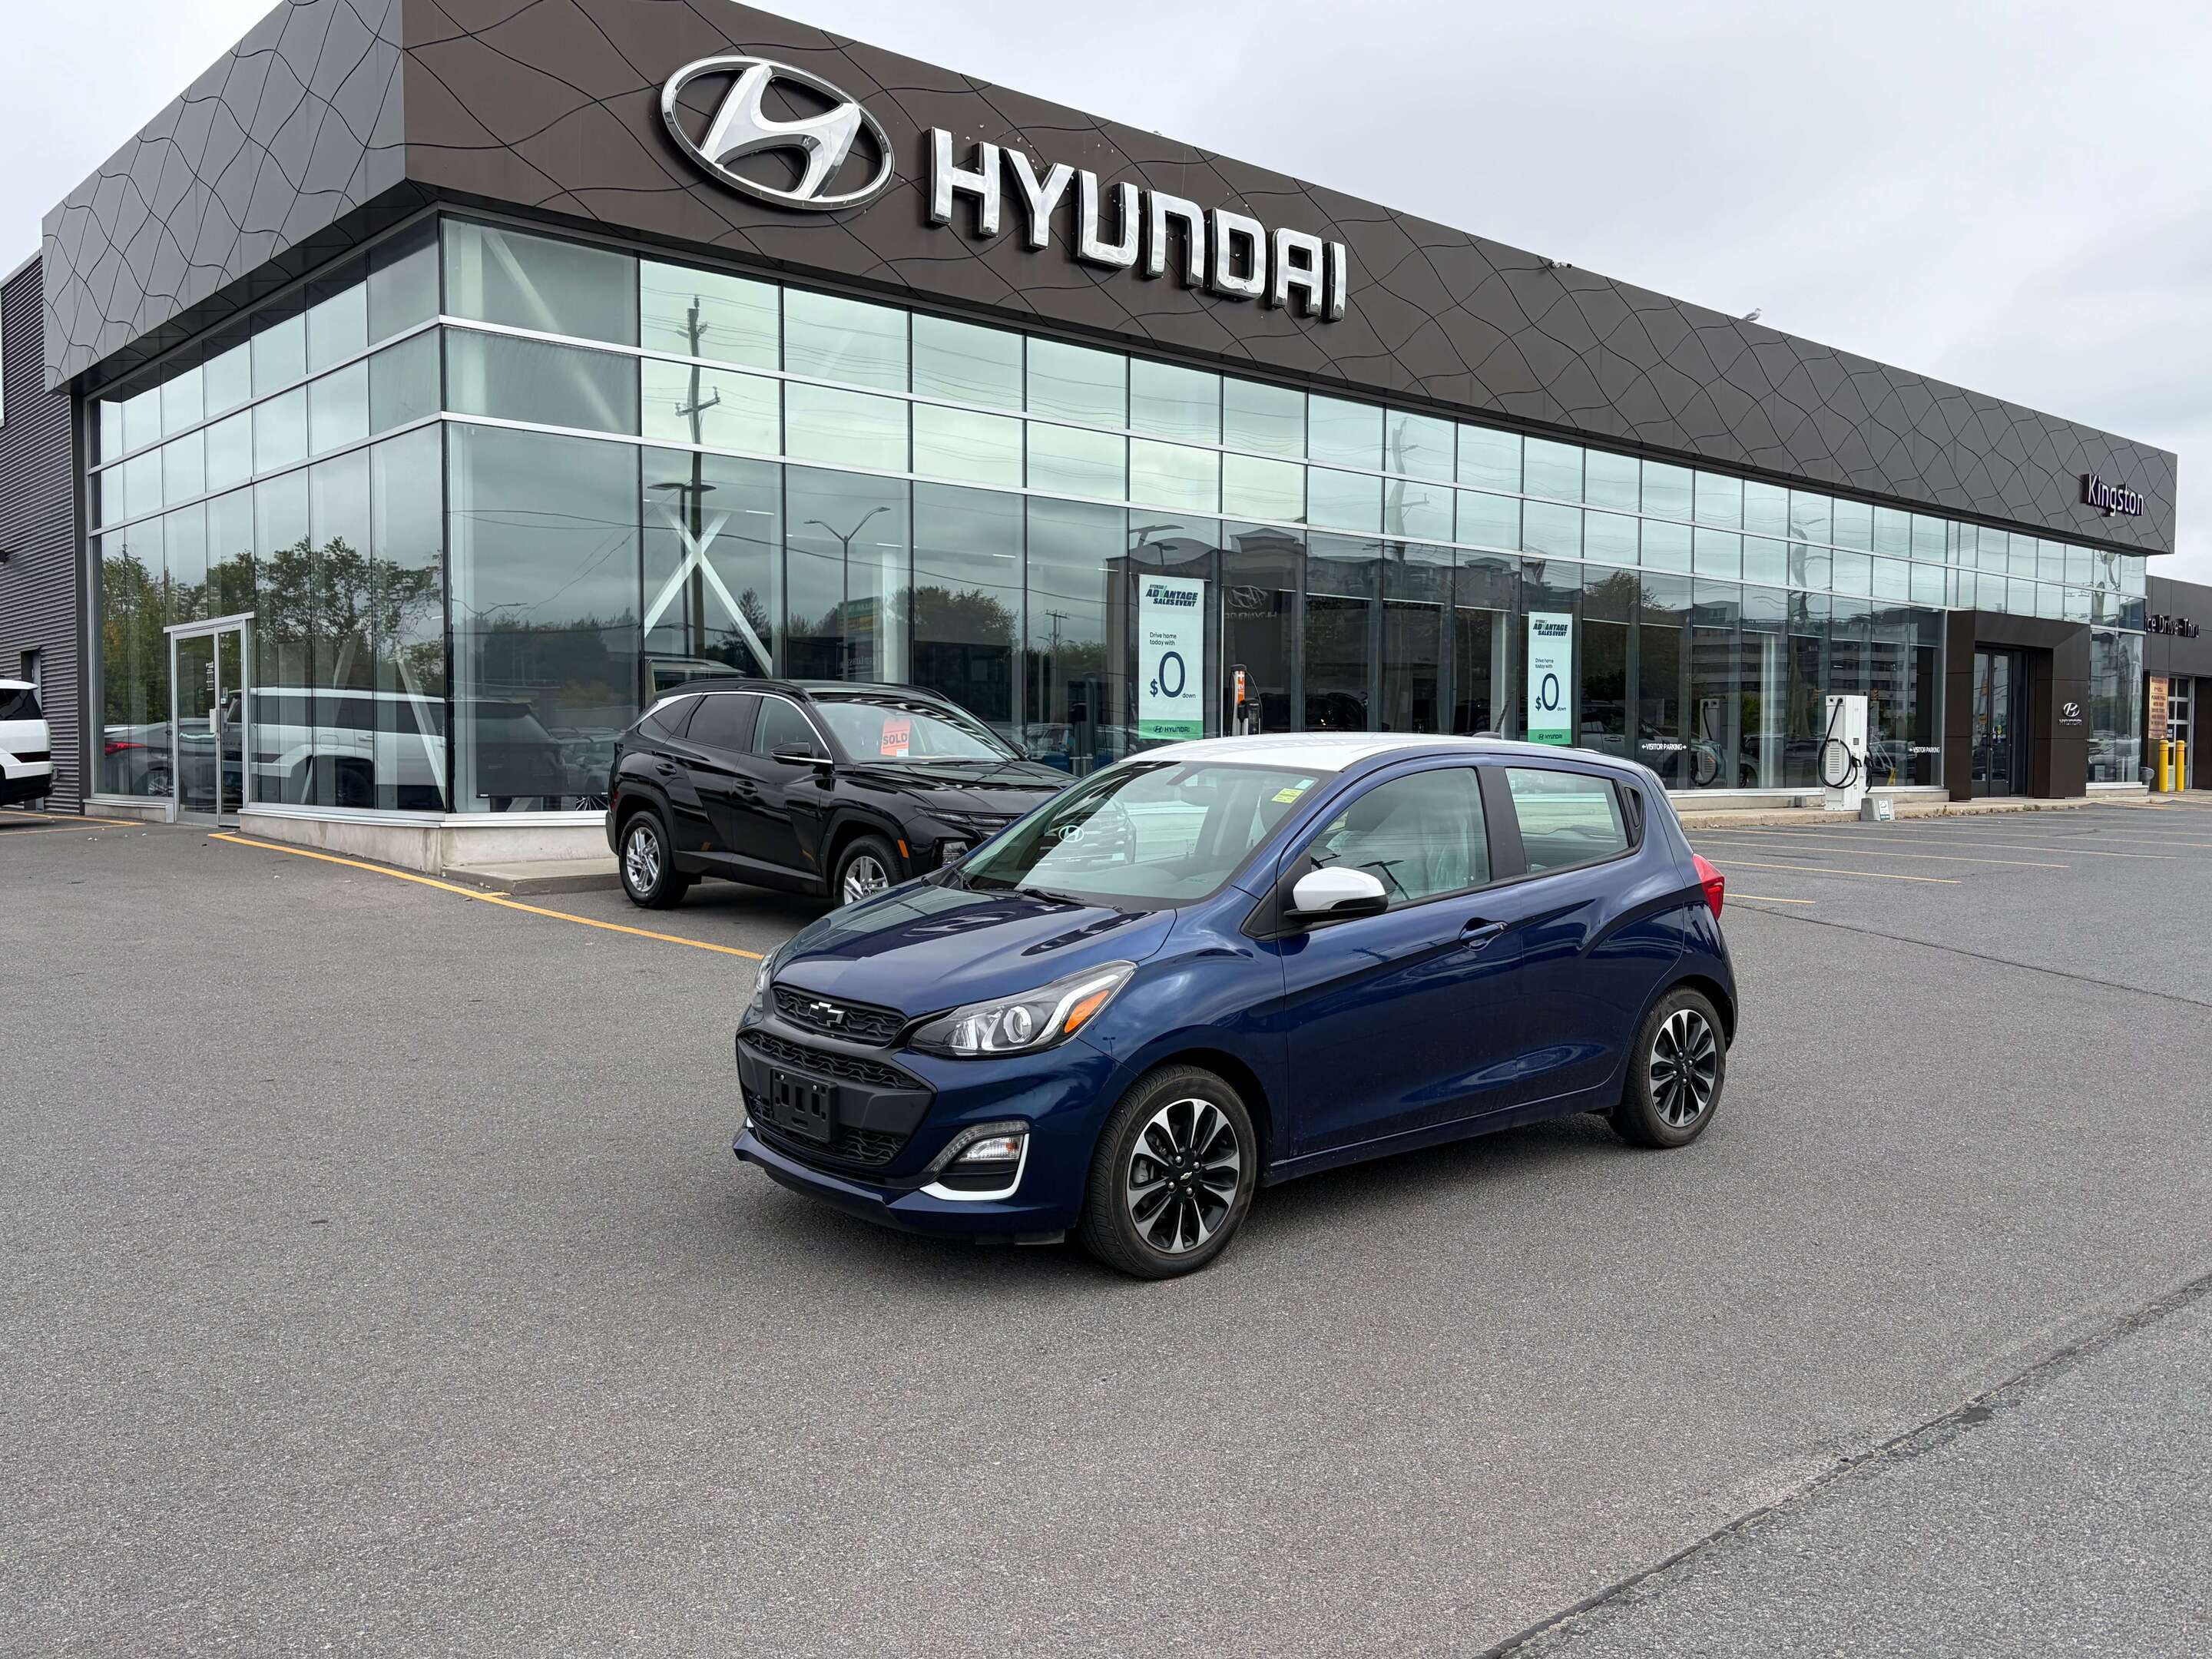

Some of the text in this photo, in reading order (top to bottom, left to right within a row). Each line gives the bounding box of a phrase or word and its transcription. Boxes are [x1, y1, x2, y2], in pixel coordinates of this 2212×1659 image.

[931, 127, 1346, 321] HYUNDAI
[2088, 473, 2144, 517] Kingston
[1146, 588, 1198, 601] ADVANTAGE
[1533, 623, 1568, 631] ADVANTAGE
[883, 733, 908, 745] SOLD
